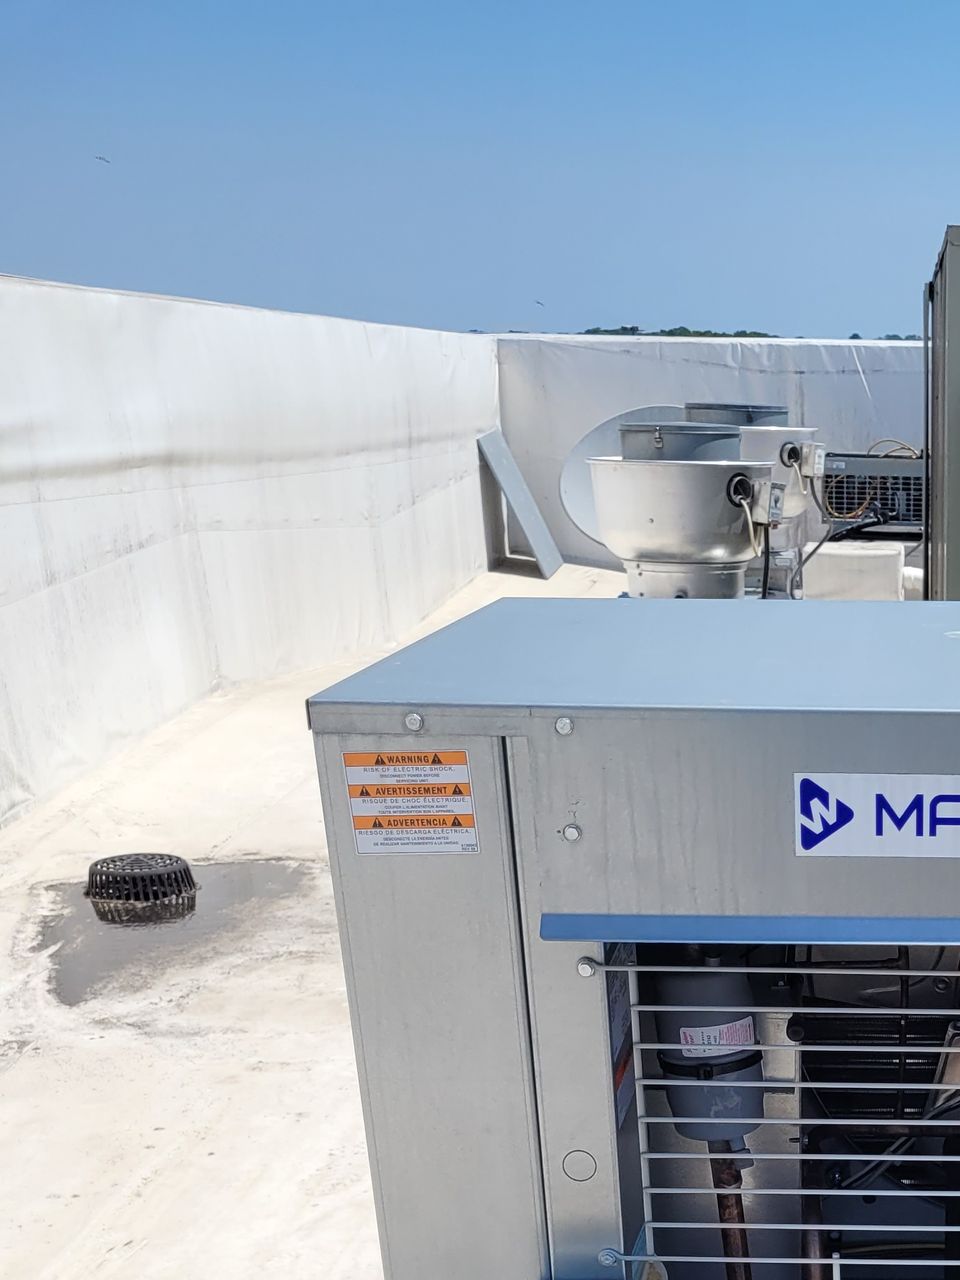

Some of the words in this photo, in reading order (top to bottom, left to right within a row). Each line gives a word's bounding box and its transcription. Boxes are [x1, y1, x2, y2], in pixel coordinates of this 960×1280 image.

[386, 755, 430, 764] WARNING
[375, 786, 447, 796] AVERTISSEMENT
[387, 818, 448, 828] ADVERTENCIA
